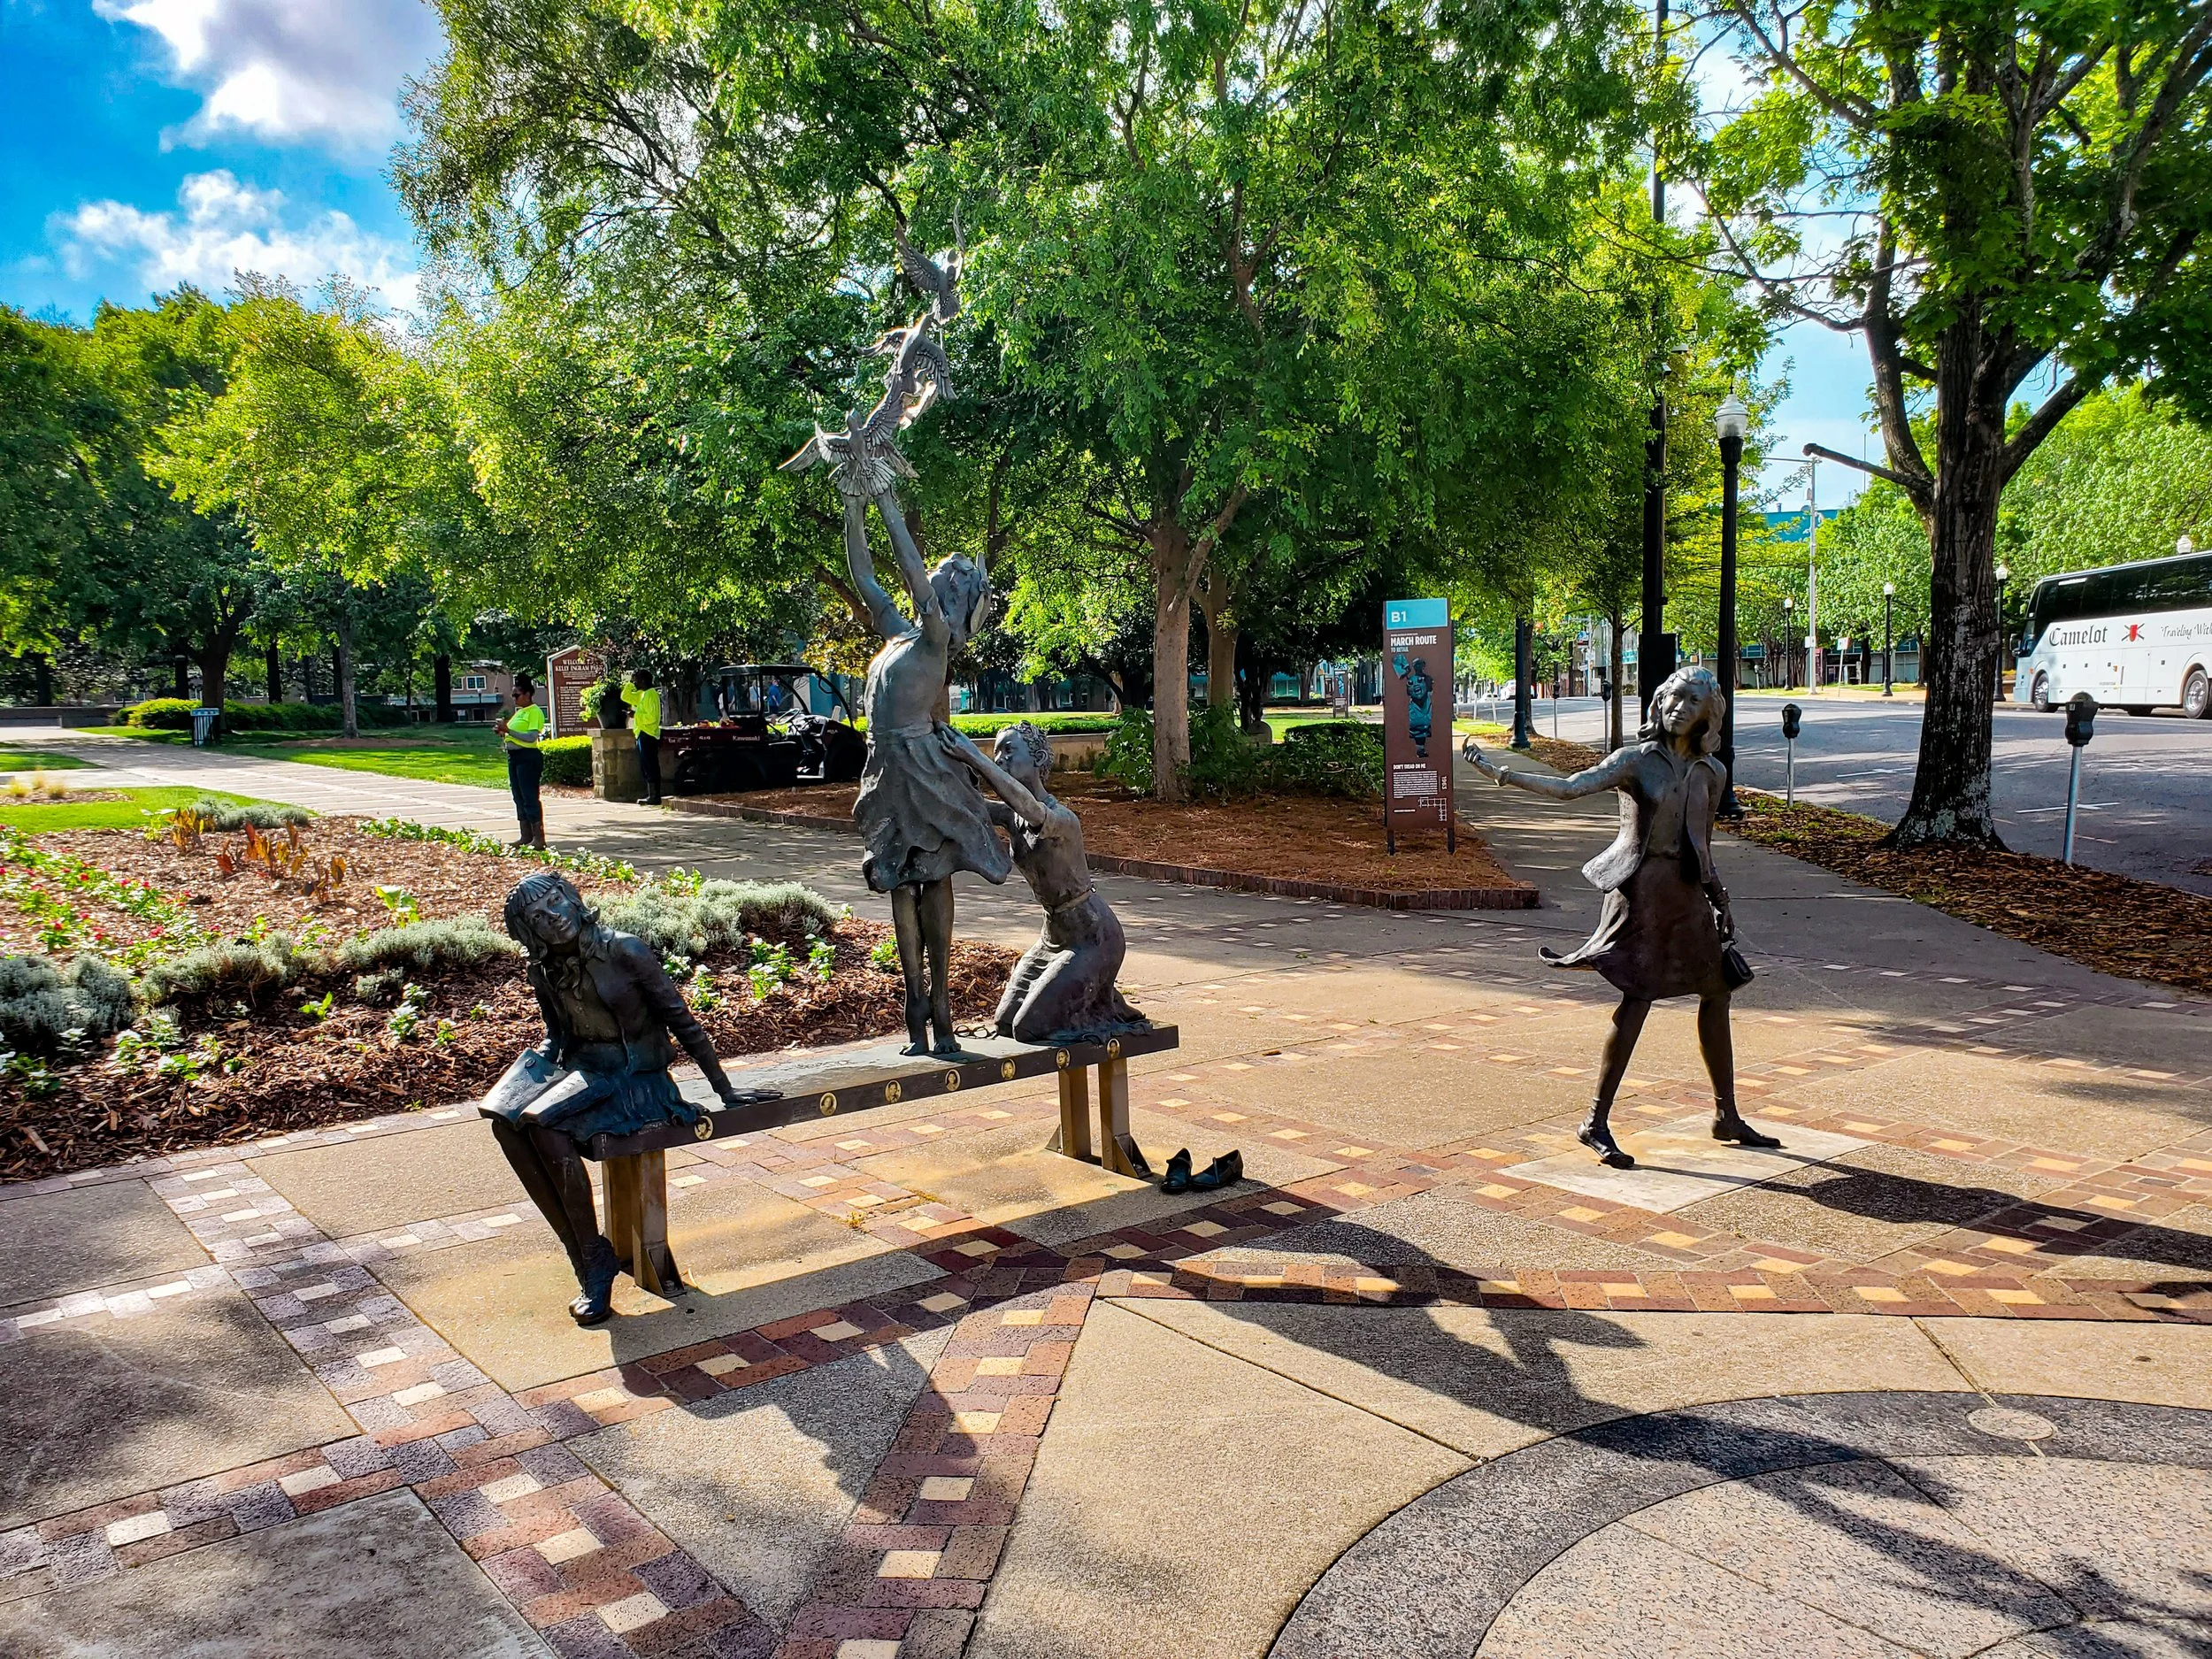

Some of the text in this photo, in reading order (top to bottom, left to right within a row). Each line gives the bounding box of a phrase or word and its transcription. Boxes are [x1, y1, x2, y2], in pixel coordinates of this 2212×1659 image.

[1391, 611, 1407, 623] B1
[2049, 625, 2108, 646] Camelot
[2161, 624, 2193, 640] Traveling
[1390, 635, 1437, 647] MARCH ROUTE
